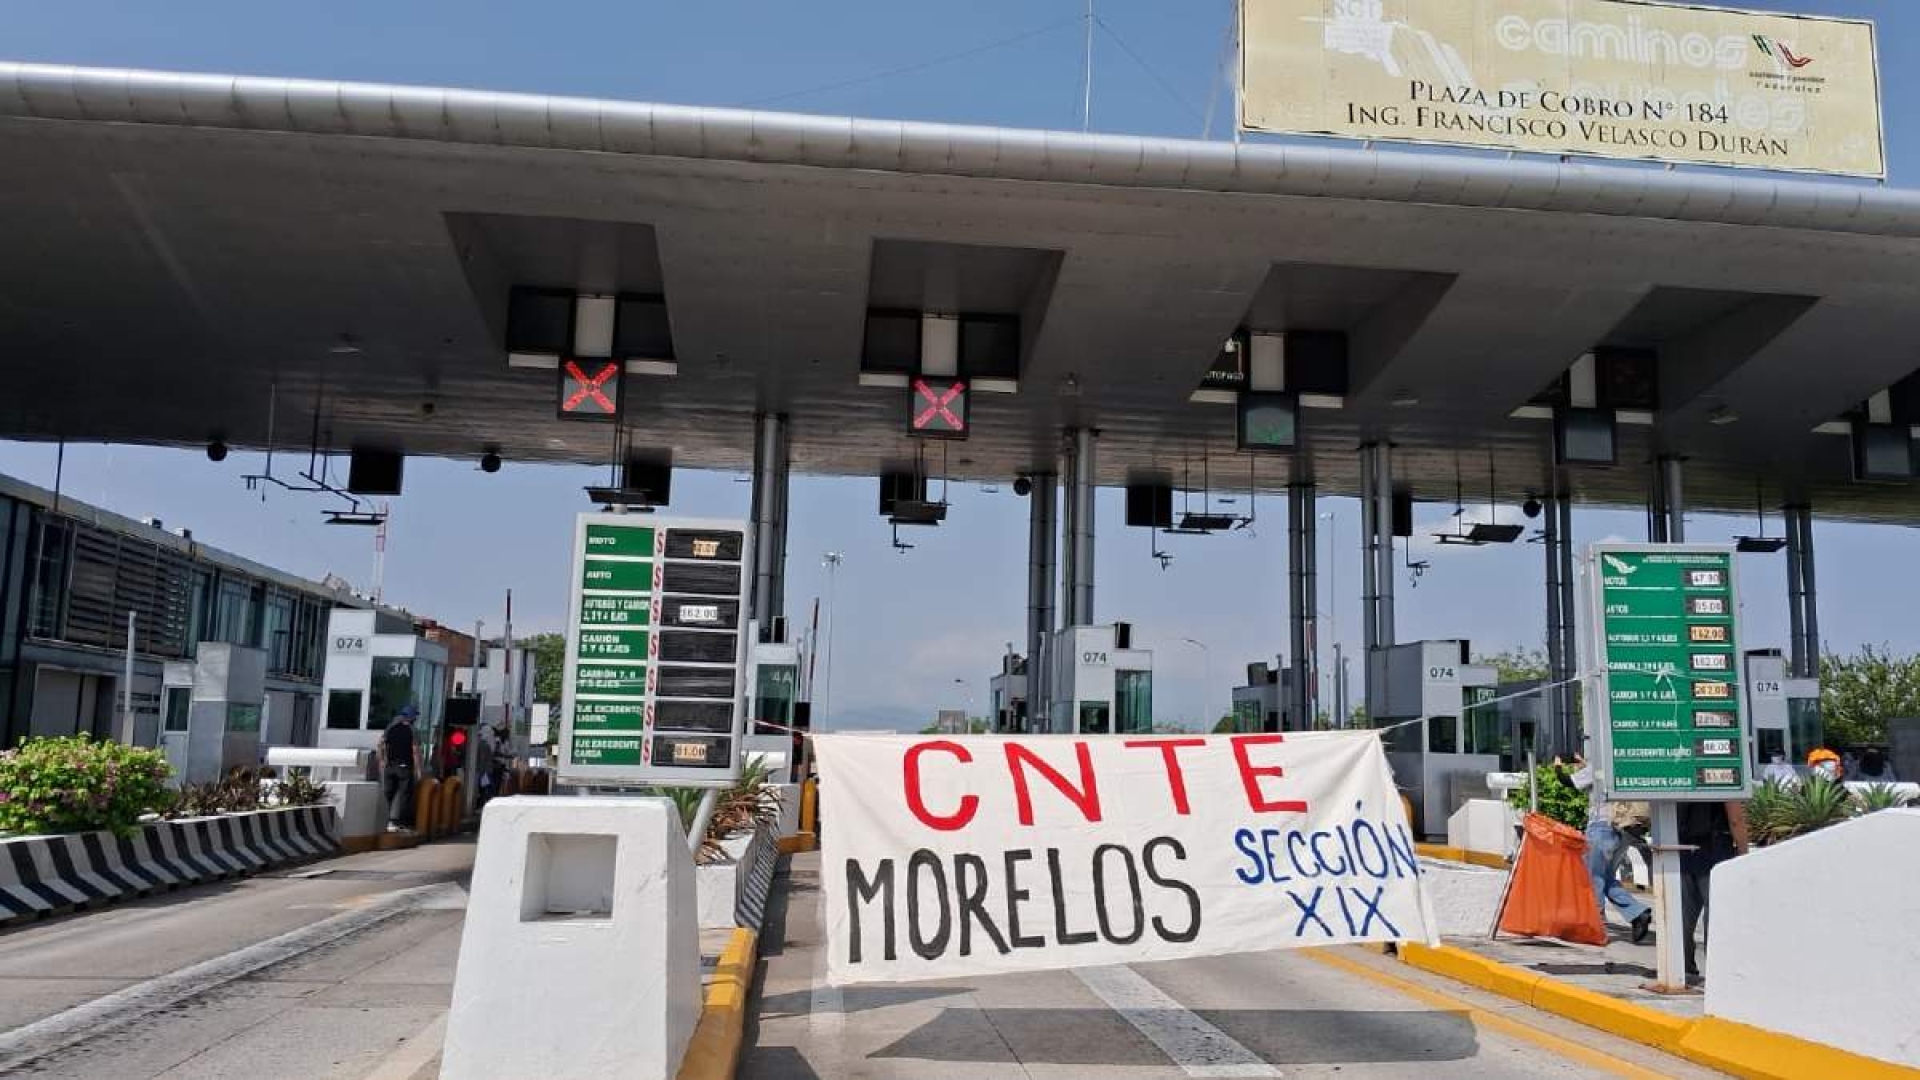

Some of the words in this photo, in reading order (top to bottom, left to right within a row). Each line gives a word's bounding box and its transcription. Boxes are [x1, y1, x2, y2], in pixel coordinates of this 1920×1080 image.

[1411, 80, 1487, 107] PLAZA
[1499, 90, 1531, 109] DE
[1541, 91, 1633, 118] COBRO
[1687, 103, 1729, 124] 184
[1348, 103, 1406, 126] ING.
[1417, 107, 1566, 139] FRANCISCO
[1579, 121, 1687, 148] VELASCO
[1699, 127, 1788, 156] DURÁN
[336, 638, 363, 649] 074
[1083, 652, 1107, 663] 074
[389, 663, 411, 676] 3A
[1430, 667, 1453, 678] 074
[1757, 682, 1779, 692] 074
[903, 735, 1308, 831] CNTE
[845, 836, 1201, 964] MORELOS
[1287, 886, 1400, 938] XIX
